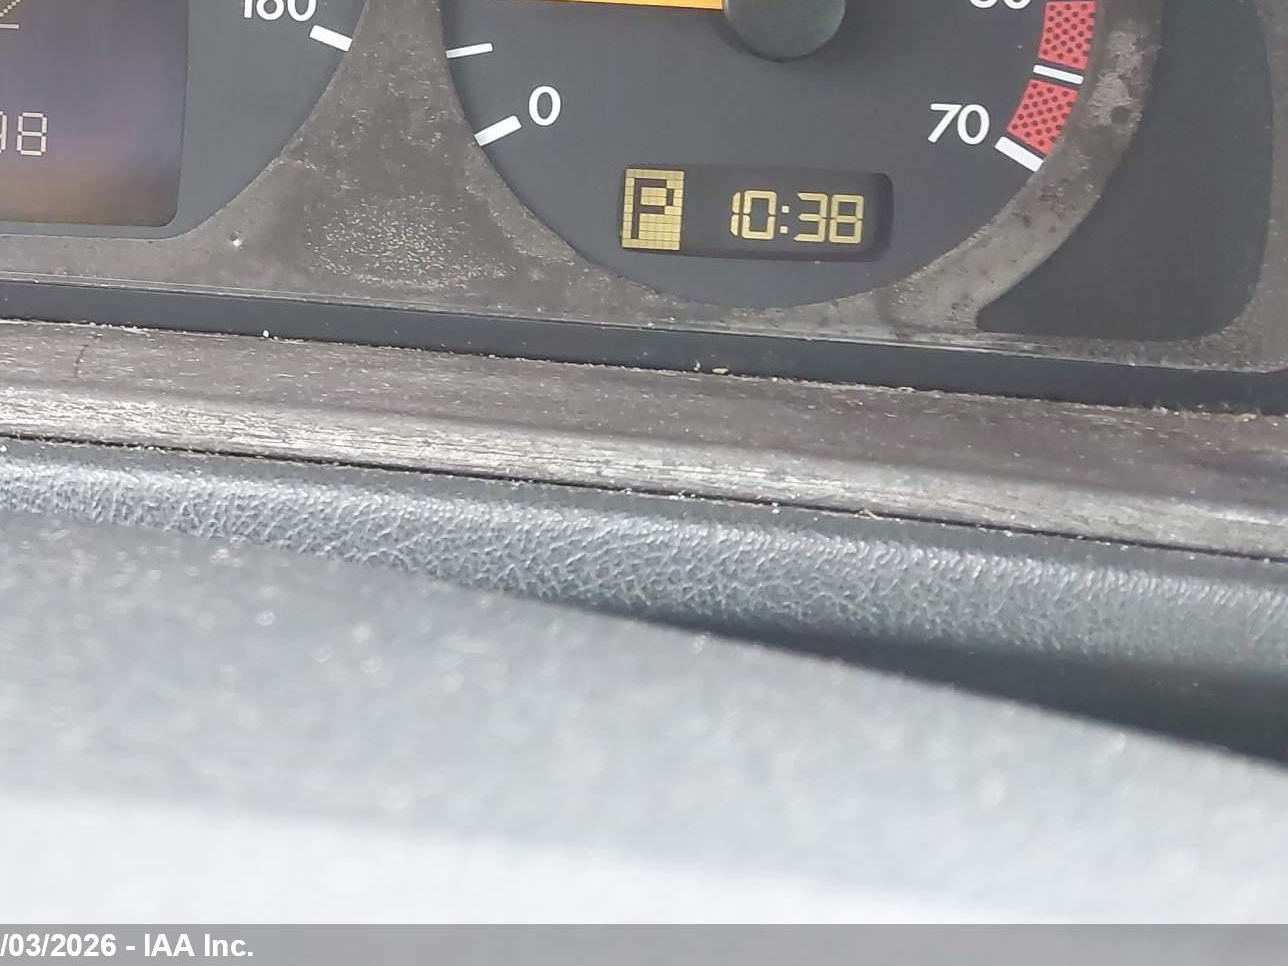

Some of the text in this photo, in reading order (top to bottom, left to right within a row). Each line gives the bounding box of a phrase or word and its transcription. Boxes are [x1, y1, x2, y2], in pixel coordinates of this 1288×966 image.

[527, 84, 562, 127] 0
[927, 102, 991, 145] 70
[628, 176, 677, 241] P
[730, 188, 865, 245] 10:38
